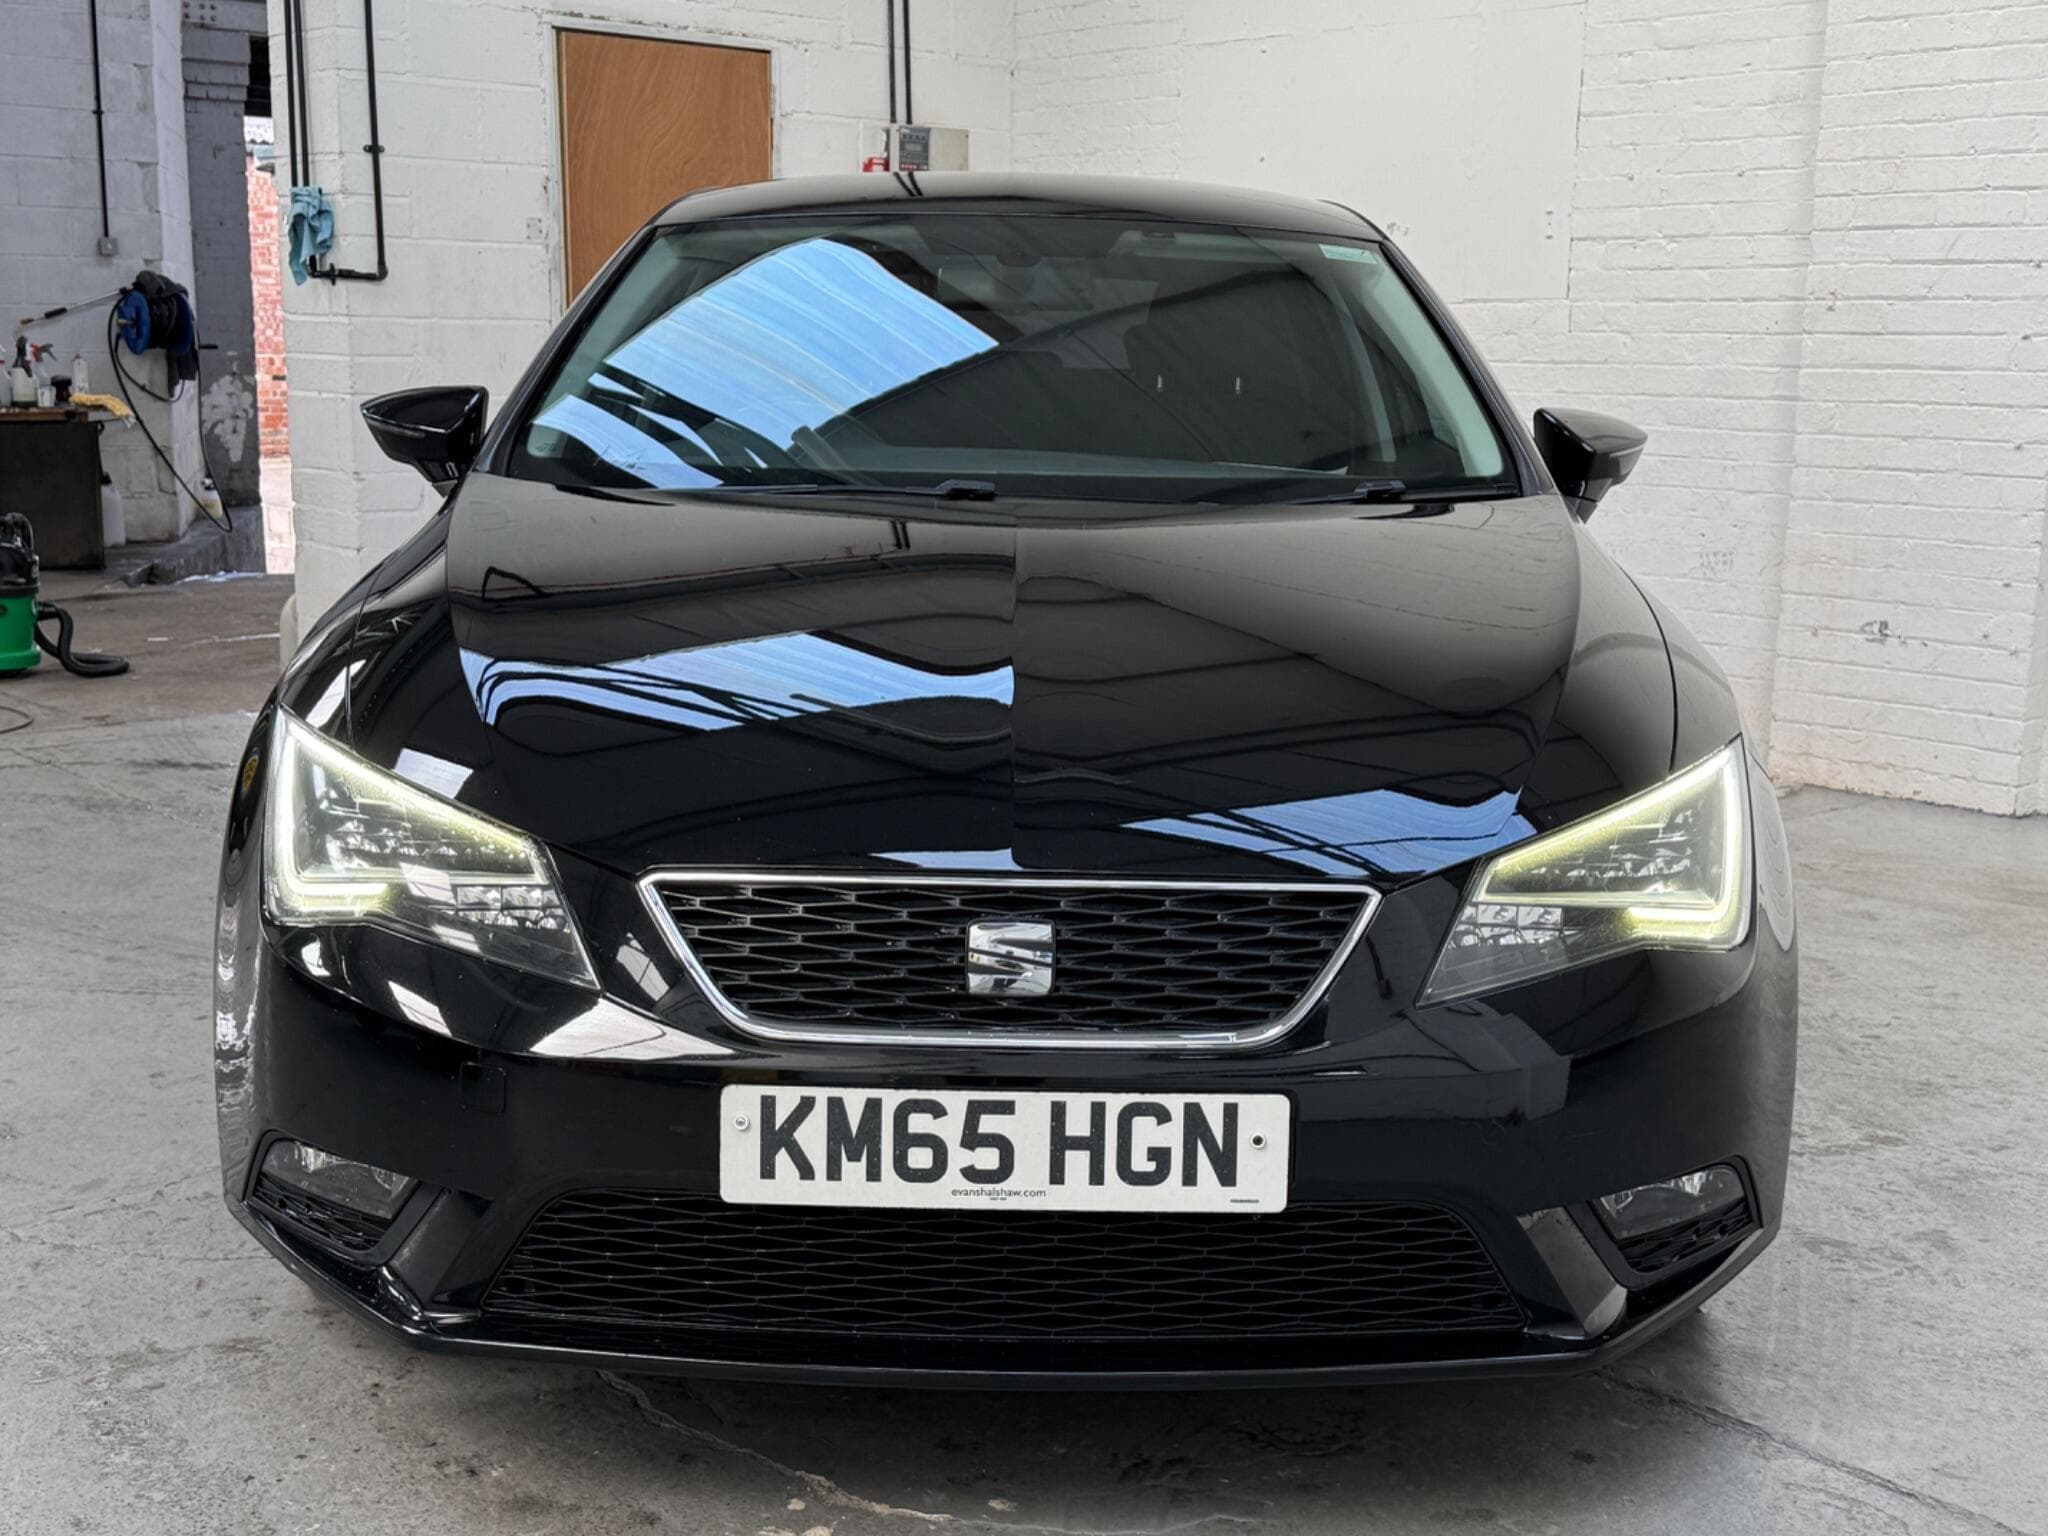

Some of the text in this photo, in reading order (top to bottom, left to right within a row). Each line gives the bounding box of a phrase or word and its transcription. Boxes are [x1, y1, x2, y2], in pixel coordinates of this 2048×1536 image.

[760, 1095, 1239, 1187] KM65 HGN
[951, 1187, 1047, 1198] evanshalshaw.com
